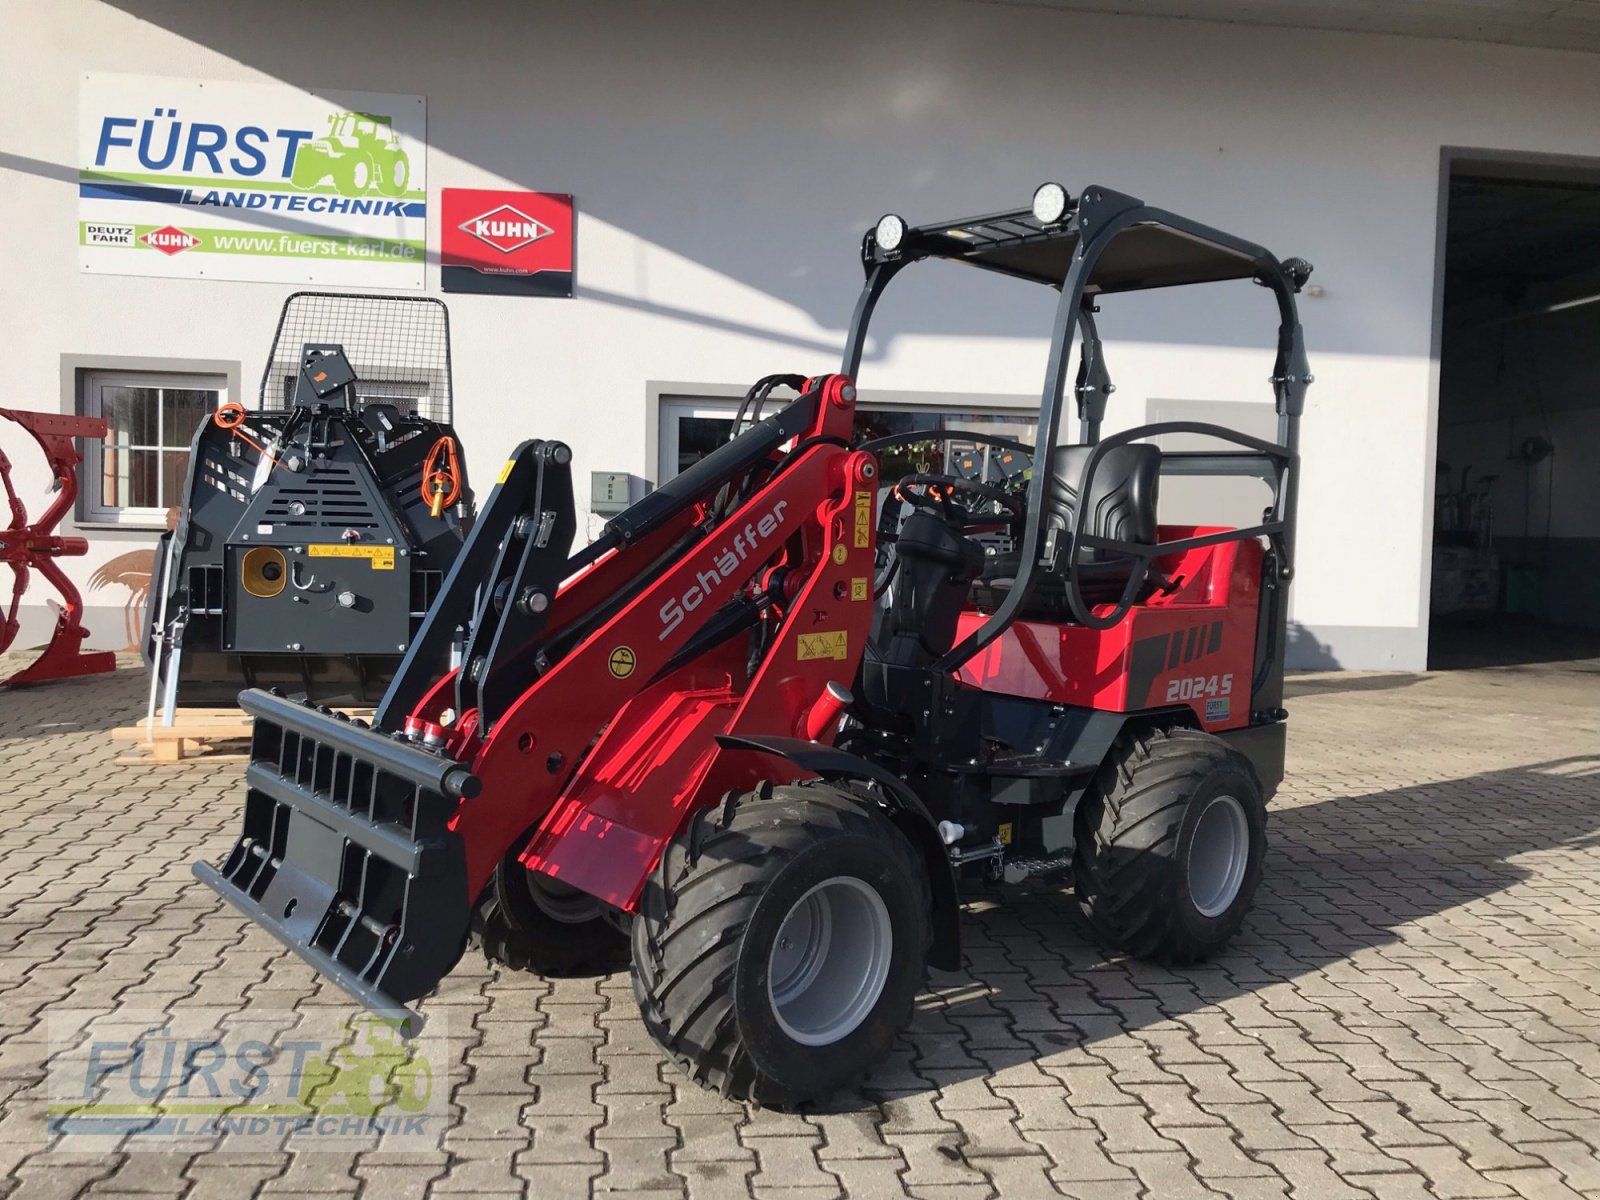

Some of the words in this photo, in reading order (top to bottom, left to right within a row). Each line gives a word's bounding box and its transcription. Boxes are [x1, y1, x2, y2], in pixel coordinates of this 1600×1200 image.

[95, 108, 313, 178] FÜRST
[182, 189, 404, 217] LANDTECHNIK
[87, 226, 133, 235] DEUTZ
[93, 234, 129, 243] FAHR
[475, 220, 538, 238] KUHN
[147, 233, 193, 247] KUHN
[213, 235, 416, 259] www.fuerst-karl.de
[483, 266, 529, 274] www.kuhn.com
[658, 500, 788, 641] Schäffer
[1166, 675, 1218, 702] 2024
[1220, 673, 1233, 695] S
